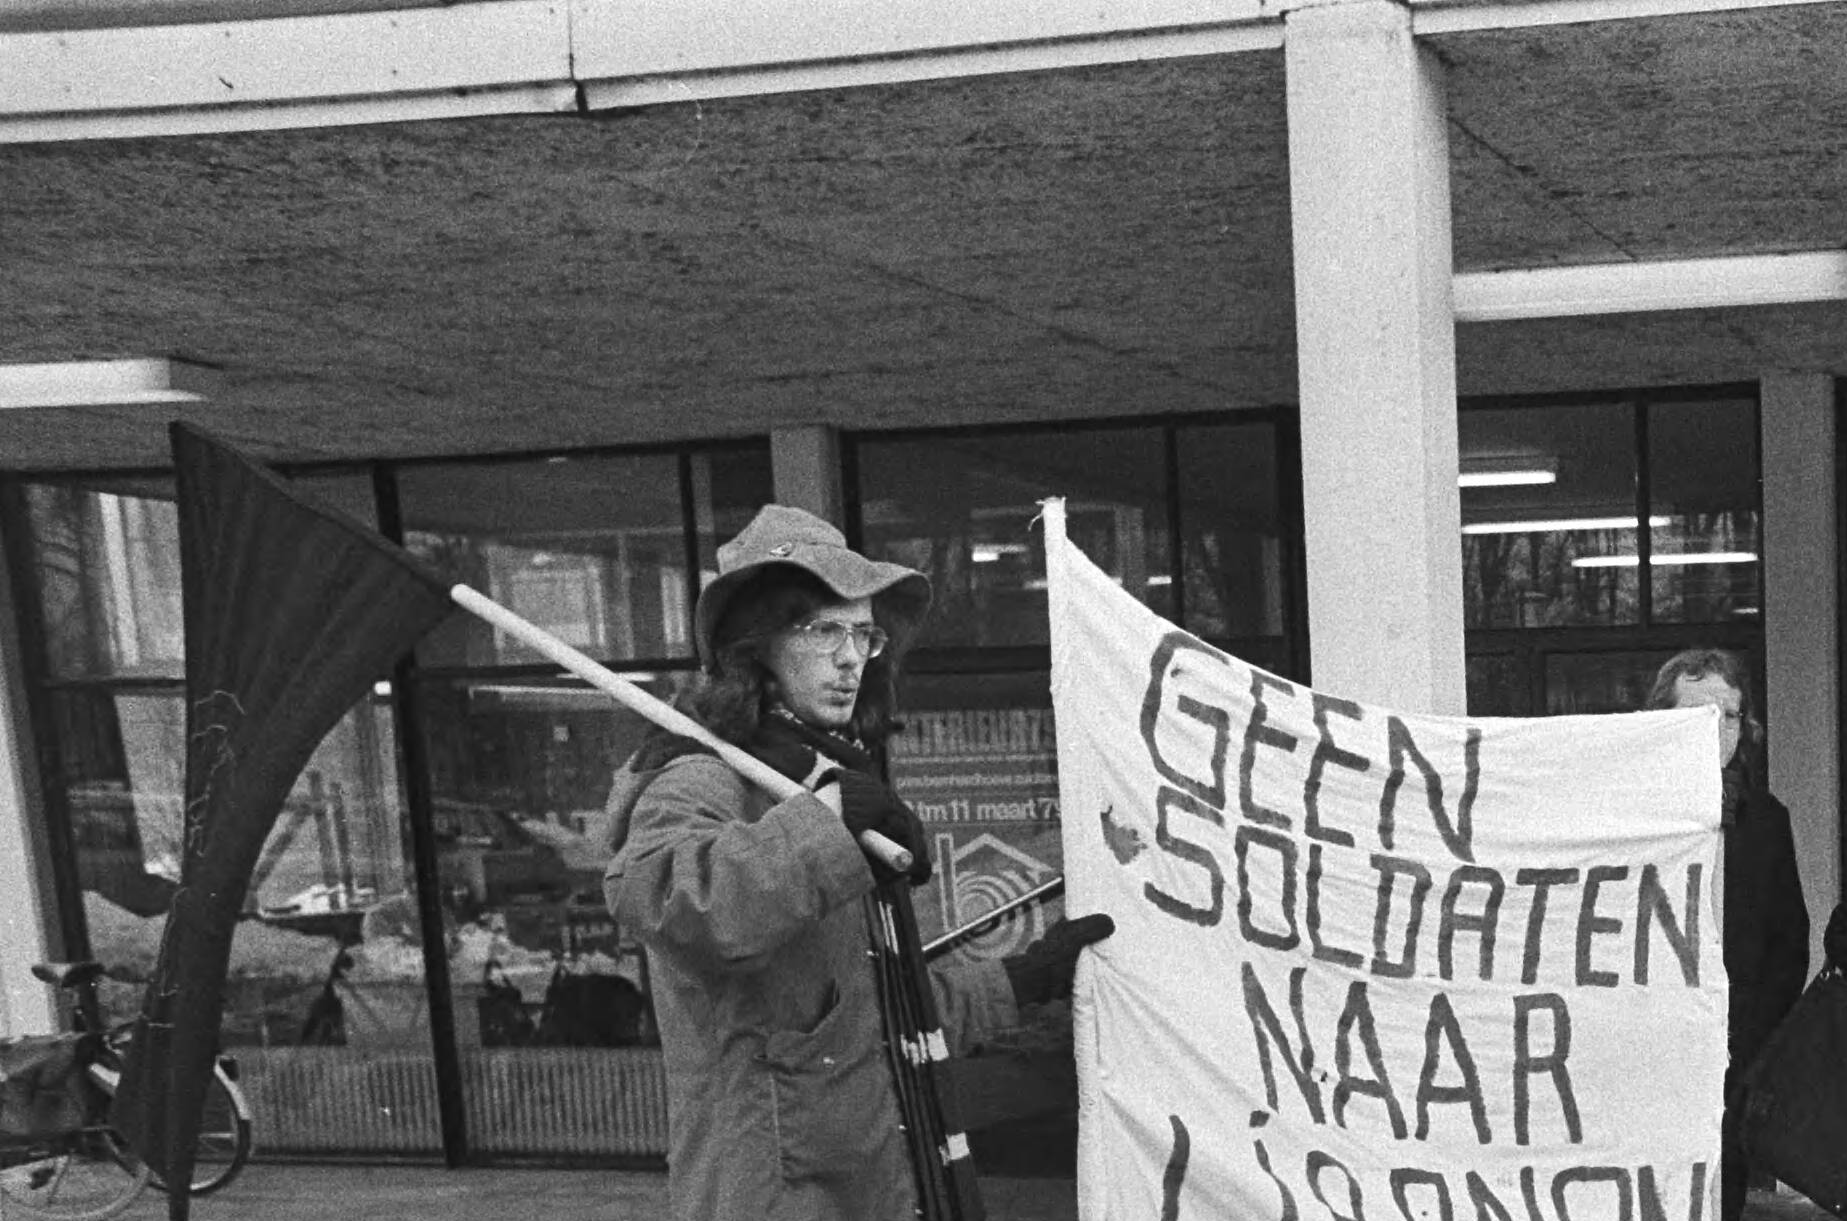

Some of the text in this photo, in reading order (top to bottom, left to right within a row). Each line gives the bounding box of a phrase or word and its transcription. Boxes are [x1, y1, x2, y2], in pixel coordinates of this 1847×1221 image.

[949, 798, 970, 821] 11
[977, 798, 1036, 821] maart
[1140, 631, 1481, 863] GEEN
[1144, 785, 1702, 988] SOLDATEN
[1241, 960, 1584, 1146] NAAR
